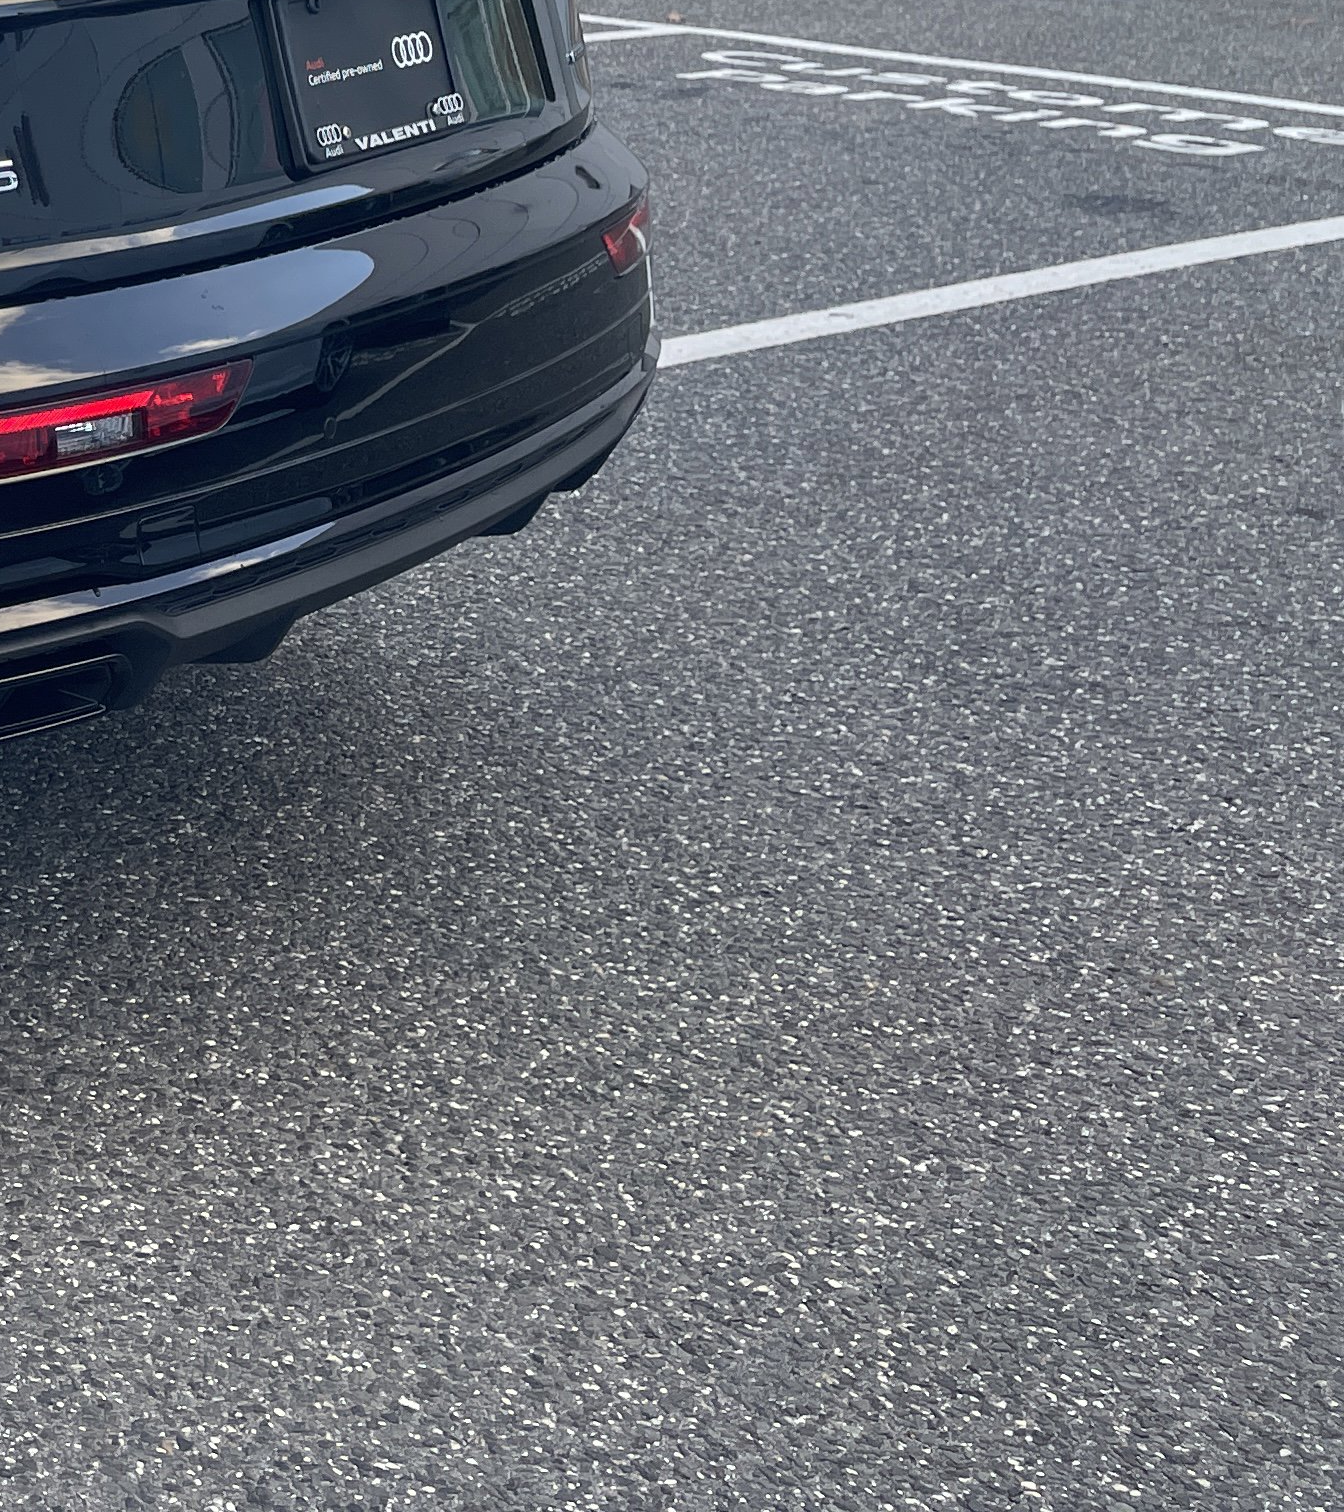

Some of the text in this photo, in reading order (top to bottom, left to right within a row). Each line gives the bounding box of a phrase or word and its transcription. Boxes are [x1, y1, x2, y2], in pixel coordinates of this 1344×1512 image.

[305, 56, 325, 71] Audi
[308, 59, 384, 87] Certified pre-owned
[447, 112, 465, 126] Audi
[355, 119, 437, 151] VALENTI
[325, 144, 345, 159] Audi
